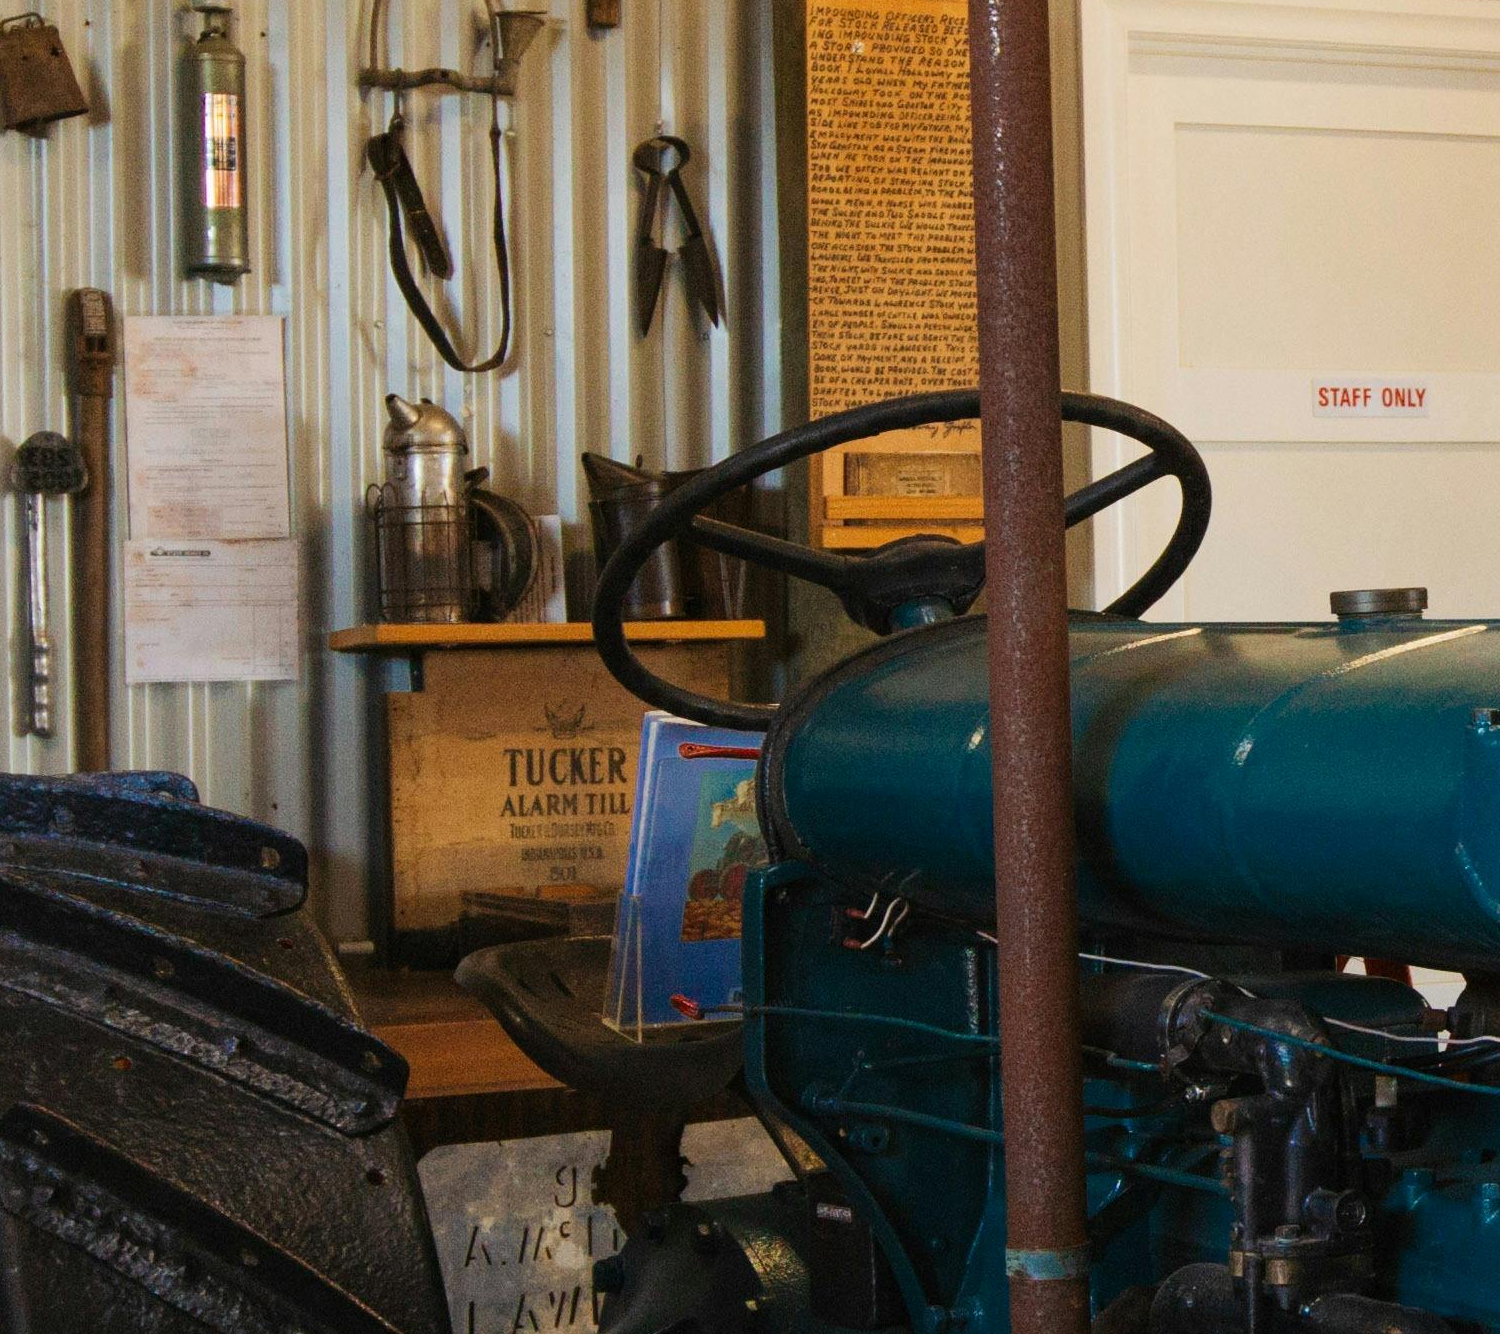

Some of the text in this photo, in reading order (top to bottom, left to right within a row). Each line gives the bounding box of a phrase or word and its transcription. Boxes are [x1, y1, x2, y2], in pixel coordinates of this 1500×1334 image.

[810, 5, 879, 19] IMPOUNDING
[809, 16, 937, 33] FOR STOCK RELEASED
[812, 28, 947, 44] ING IMPOUNDING STOCK
[871, 43, 925, 54] PROVIDED
[929, 46, 942, 56] SO
[810, 52, 965, 68] UNDERSTAND THE REASON
[811, 61, 842, 73] BOOK
[1317, 387, 1428, 409] STAFF ONLY
[502, 746, 628, 787] TUCKER
[500, 792, 631, 817] ALARM TILL
